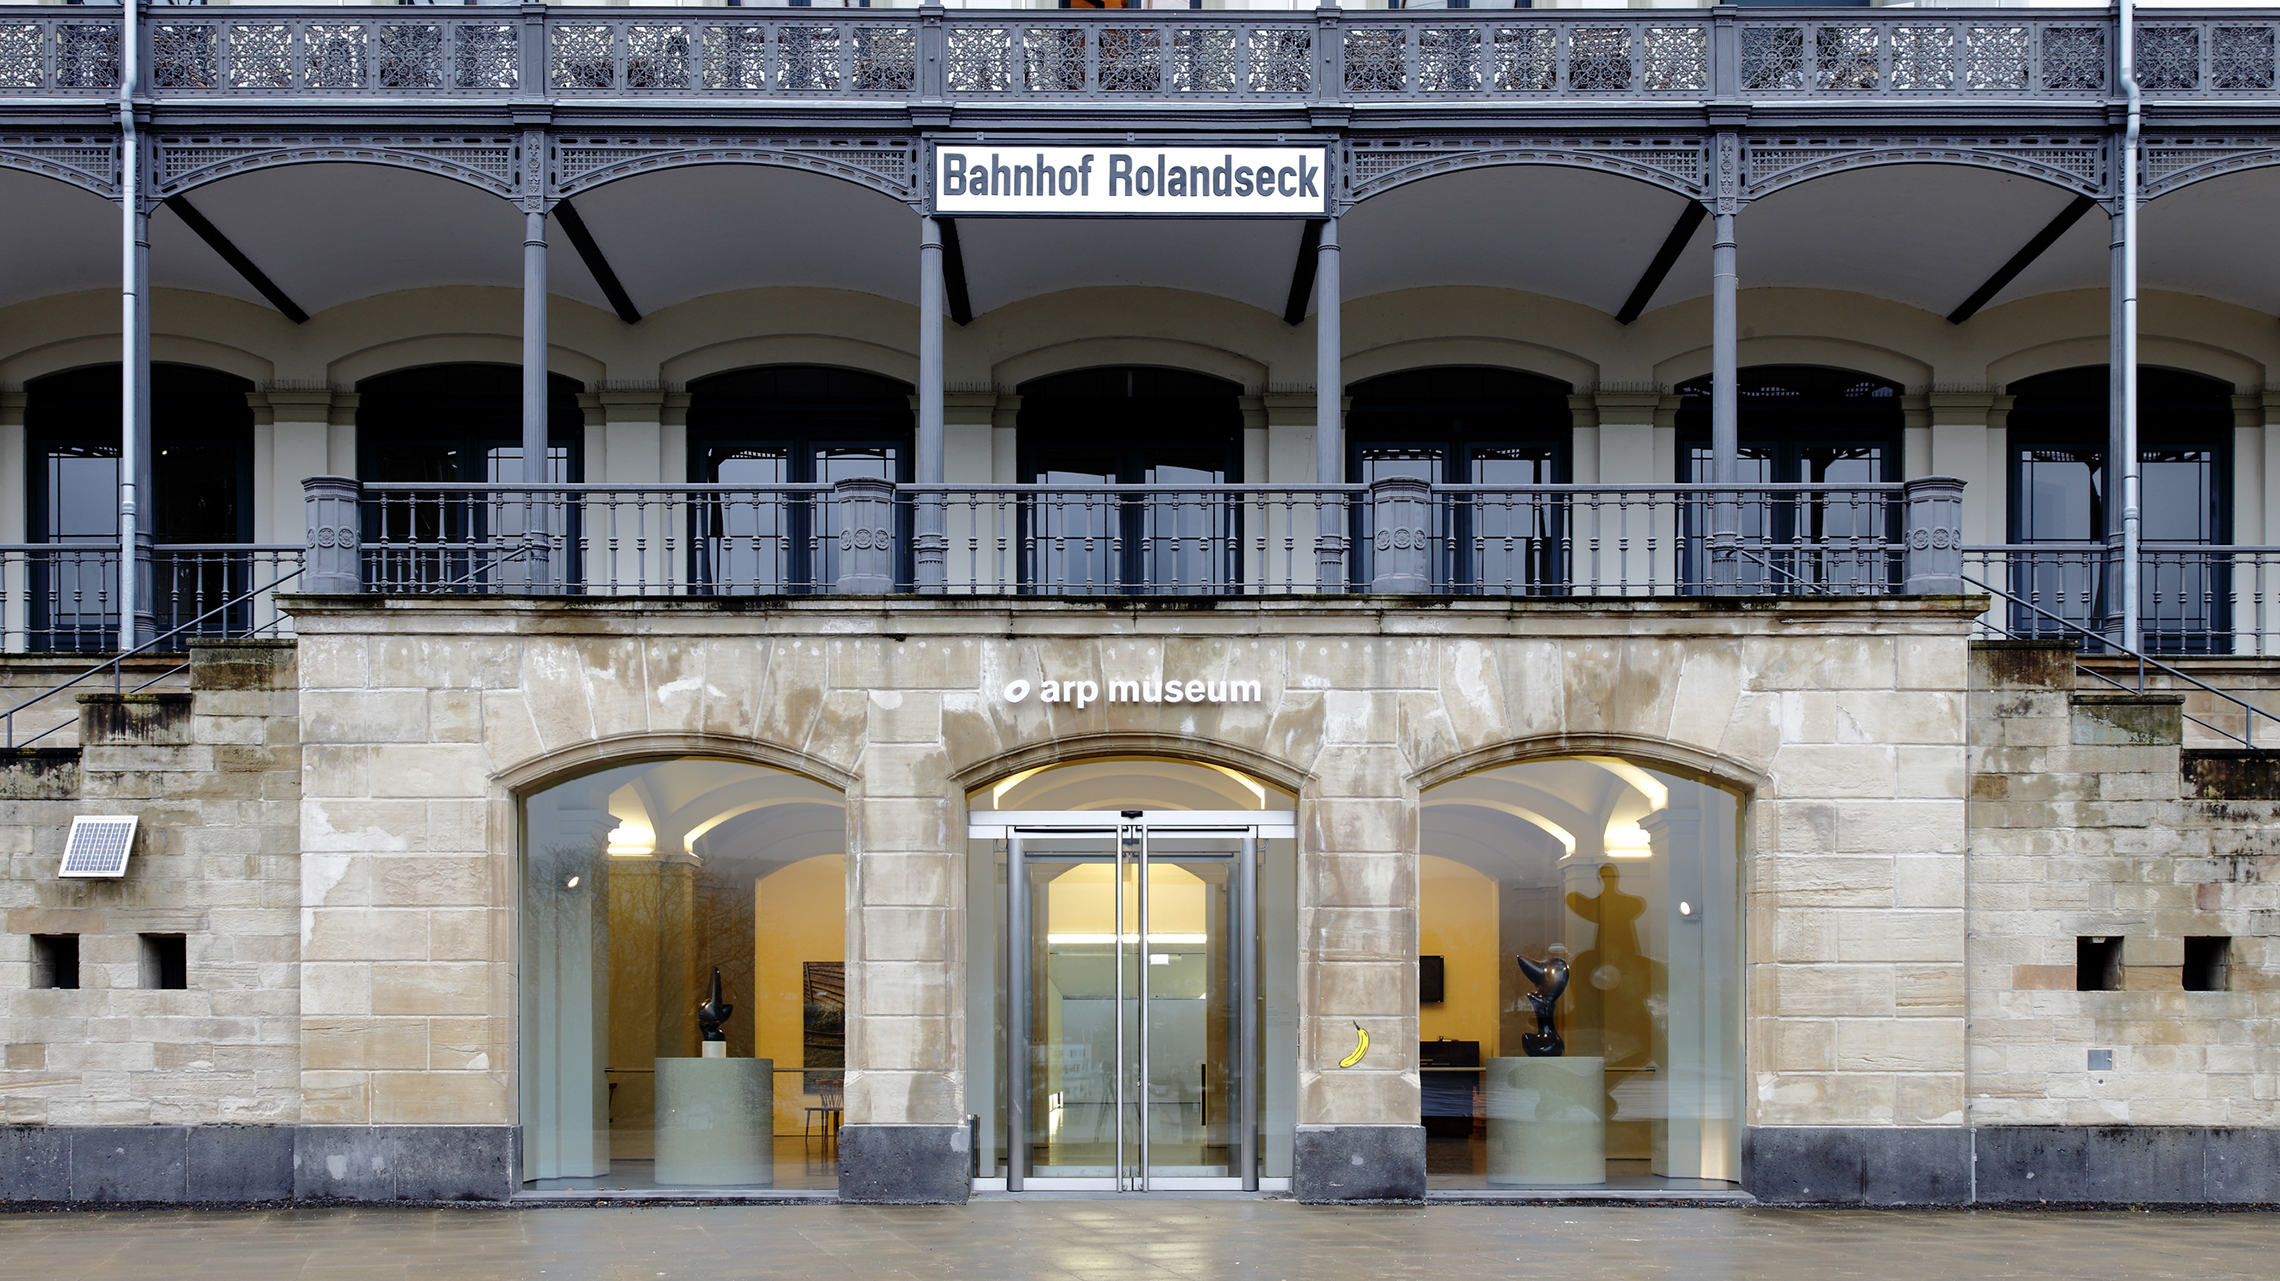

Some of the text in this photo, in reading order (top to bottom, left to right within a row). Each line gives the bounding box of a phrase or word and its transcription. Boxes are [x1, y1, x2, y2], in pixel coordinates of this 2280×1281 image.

[943, 153, 1320, 198] Bahnhof Rolandseck
[1040, 679, 1099, 709] arp
[1108, 679, 1262, 703] museum
